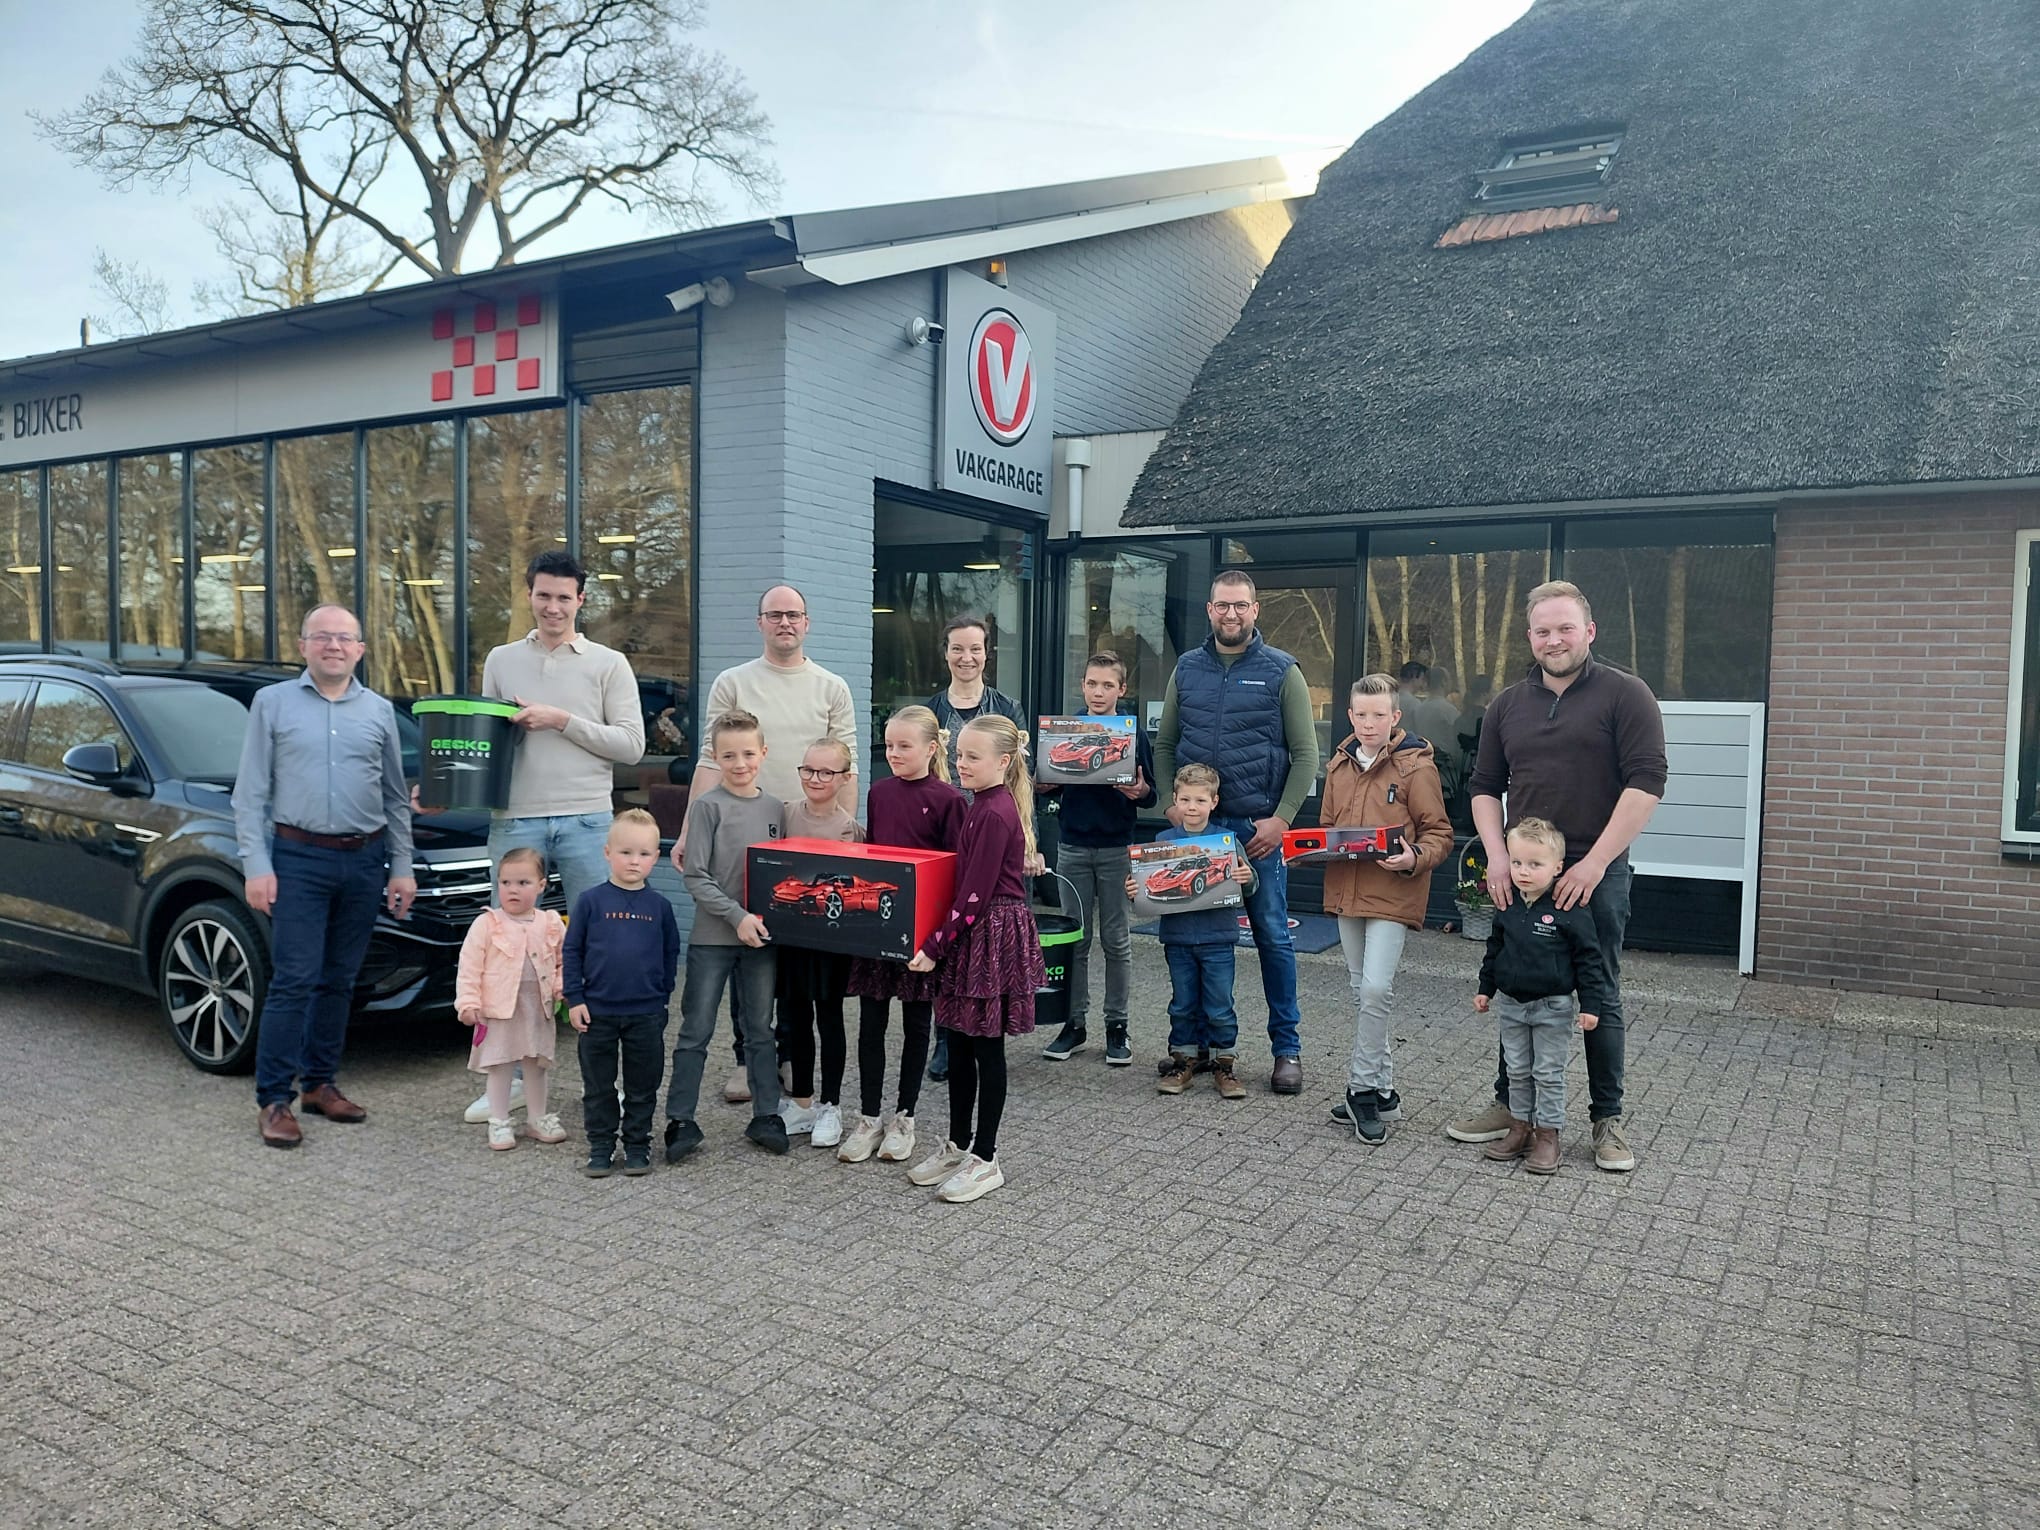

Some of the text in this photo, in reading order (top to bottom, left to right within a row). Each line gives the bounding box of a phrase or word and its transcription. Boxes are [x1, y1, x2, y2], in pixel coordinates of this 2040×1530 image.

[985, 332, 1032, 426] V
[13, 393, 83, 439] BIJKER
[955, 448, 1044, 497] VAKGARAGE
[431, 739, 491, 752] GECKO
[1143, 845, 1178, 854] TECHNIC
